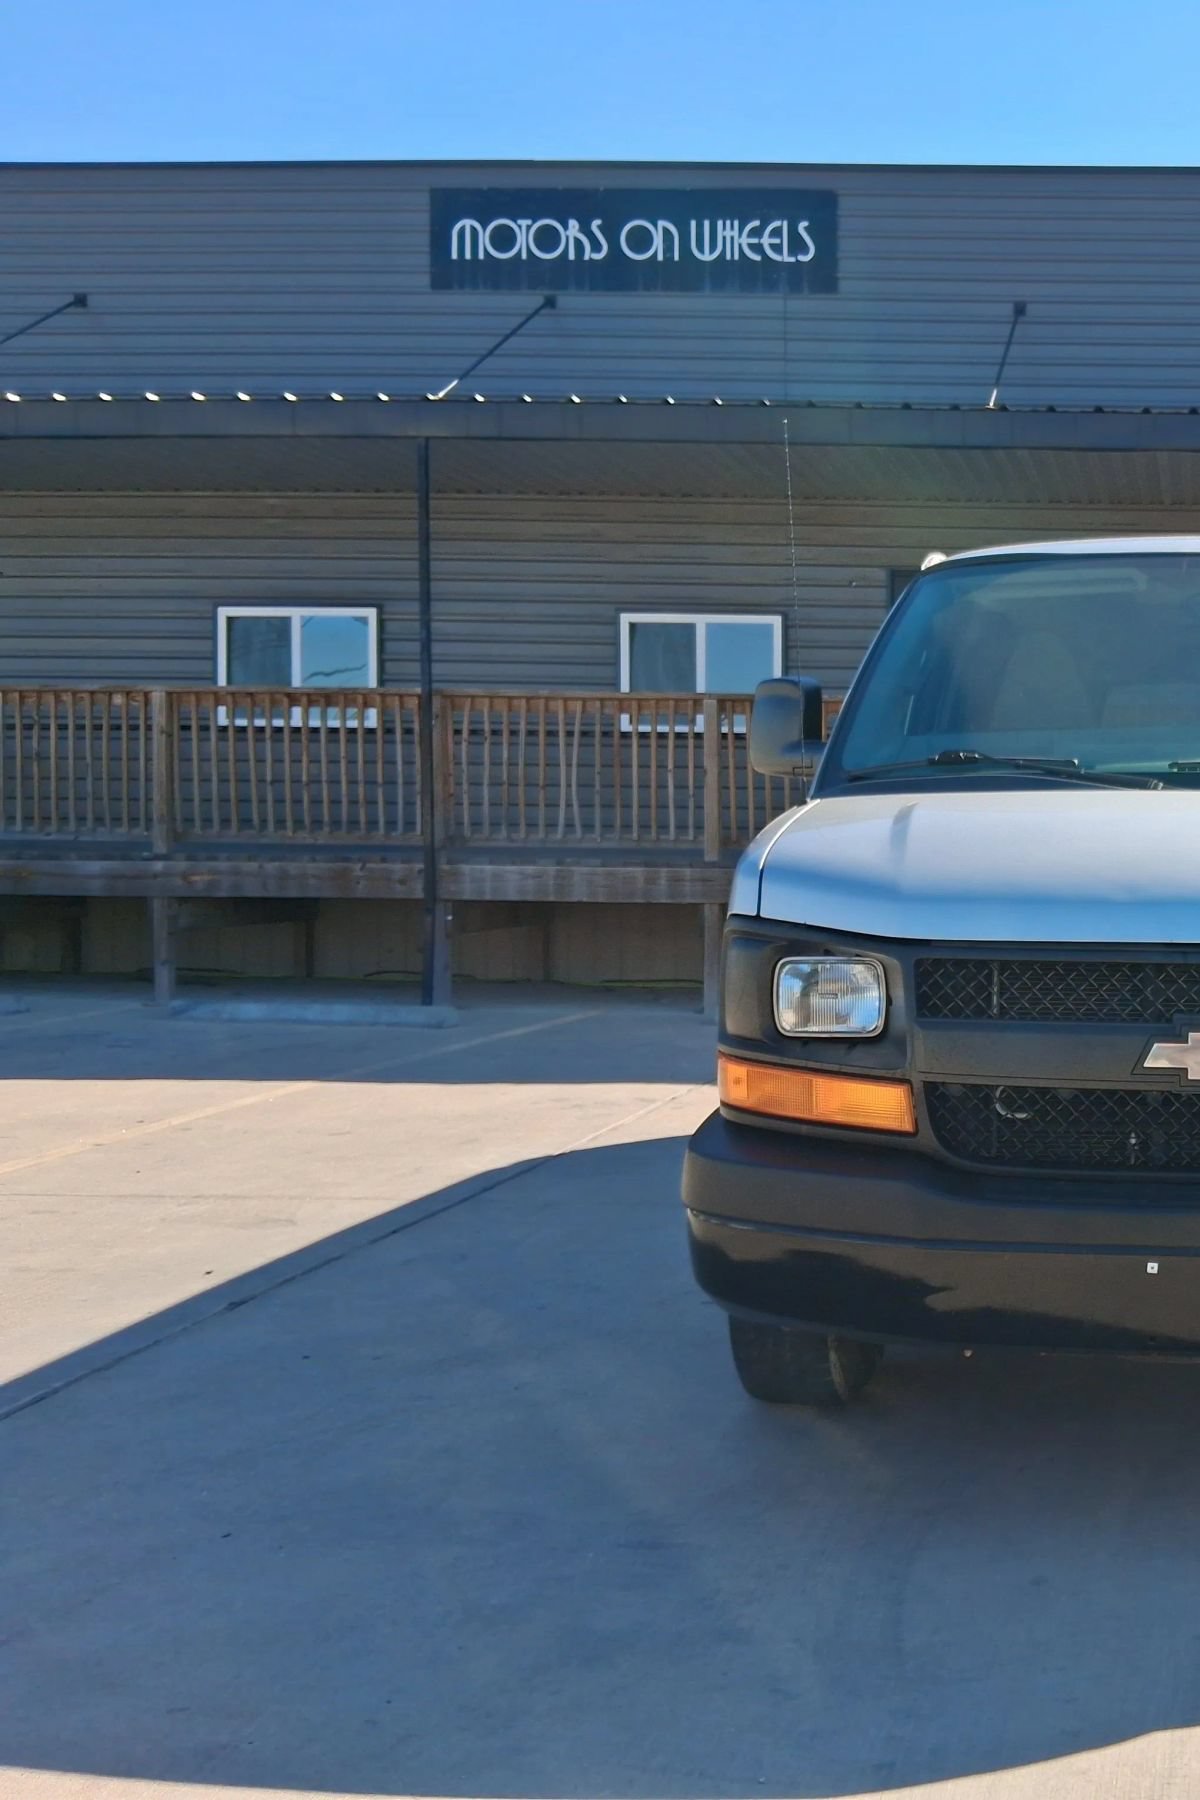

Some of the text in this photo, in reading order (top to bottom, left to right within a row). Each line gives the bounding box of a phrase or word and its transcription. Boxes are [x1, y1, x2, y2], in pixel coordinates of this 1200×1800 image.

[451, 218, 816, 263] MOTORS ON WHEELS
